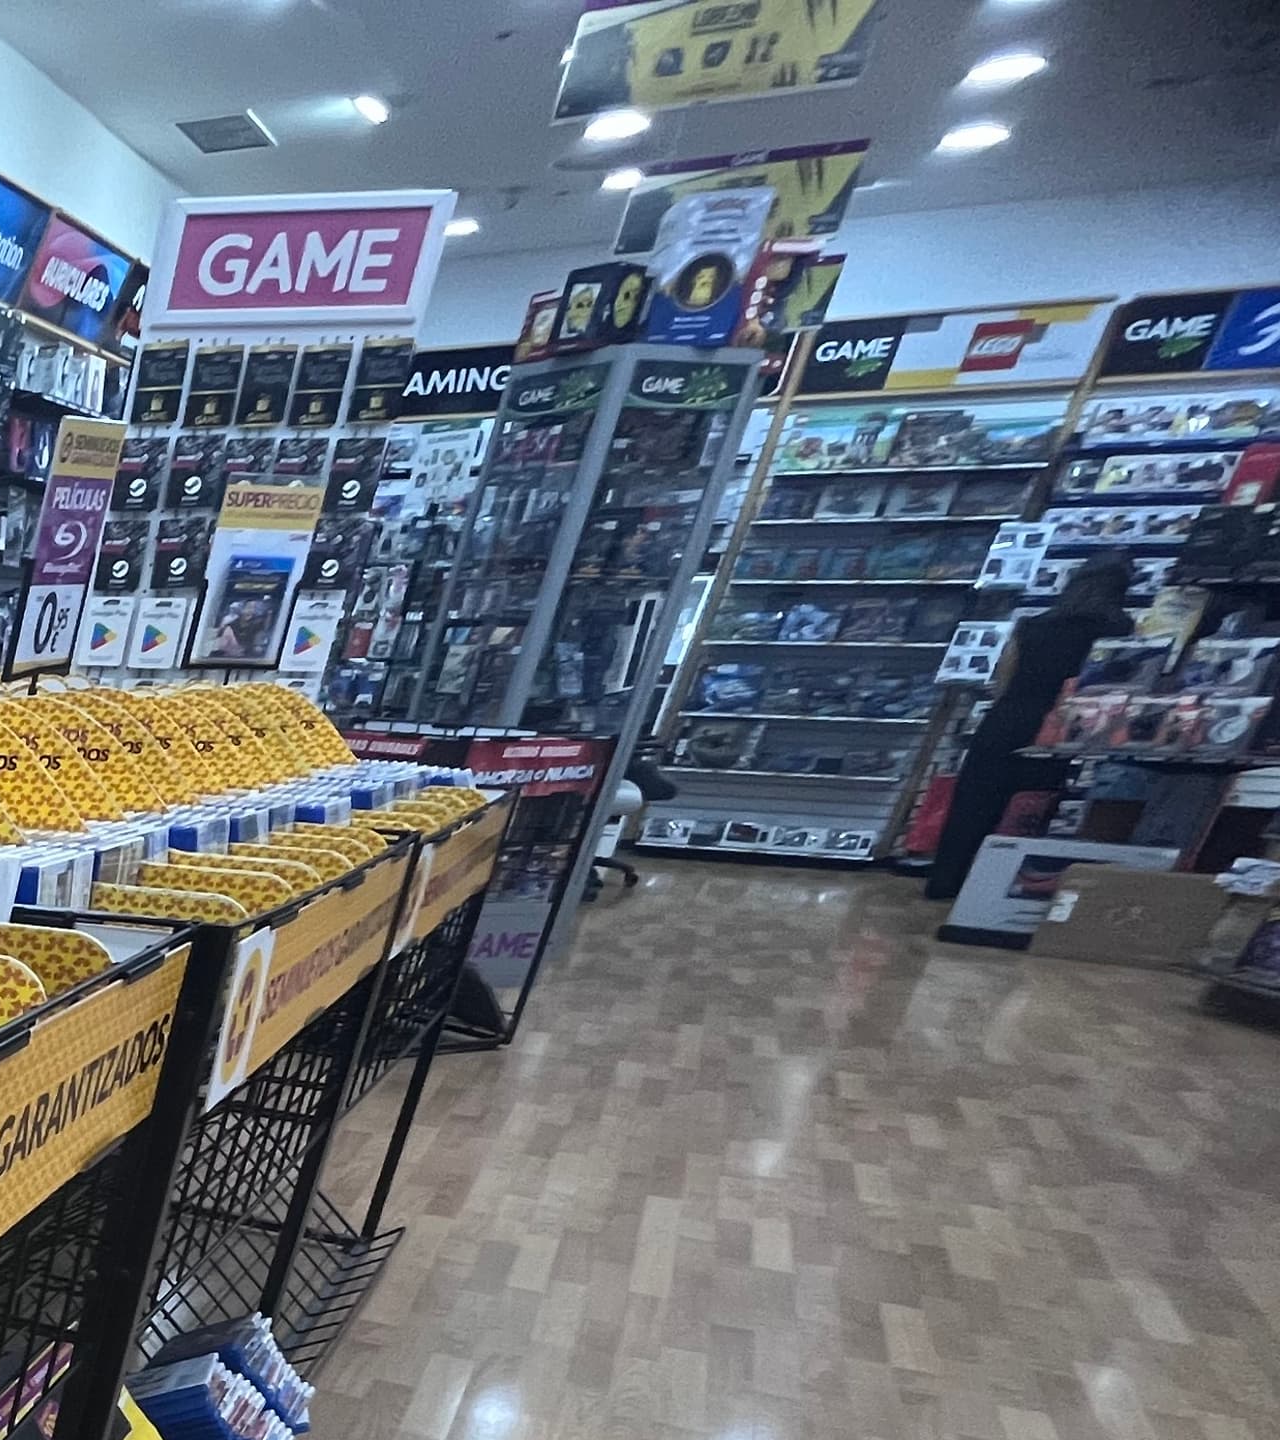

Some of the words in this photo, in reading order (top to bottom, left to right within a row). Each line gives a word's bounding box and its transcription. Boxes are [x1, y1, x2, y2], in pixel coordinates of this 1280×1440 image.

[198, 228, 401, 297] GAME
[41, 255, 111, 313] AURICULARES
[1125, 313, 1218, 341] GAME
[815, 336, 895, 362] GAME
[972, 333, 1021, 357] LEGO
[402, 363, 512, 398] AMING
[641, 374, 685, 395] GAME
[52, 482, 106, 511] PELÍCULAS
[473, 932, 541, 959] AME
